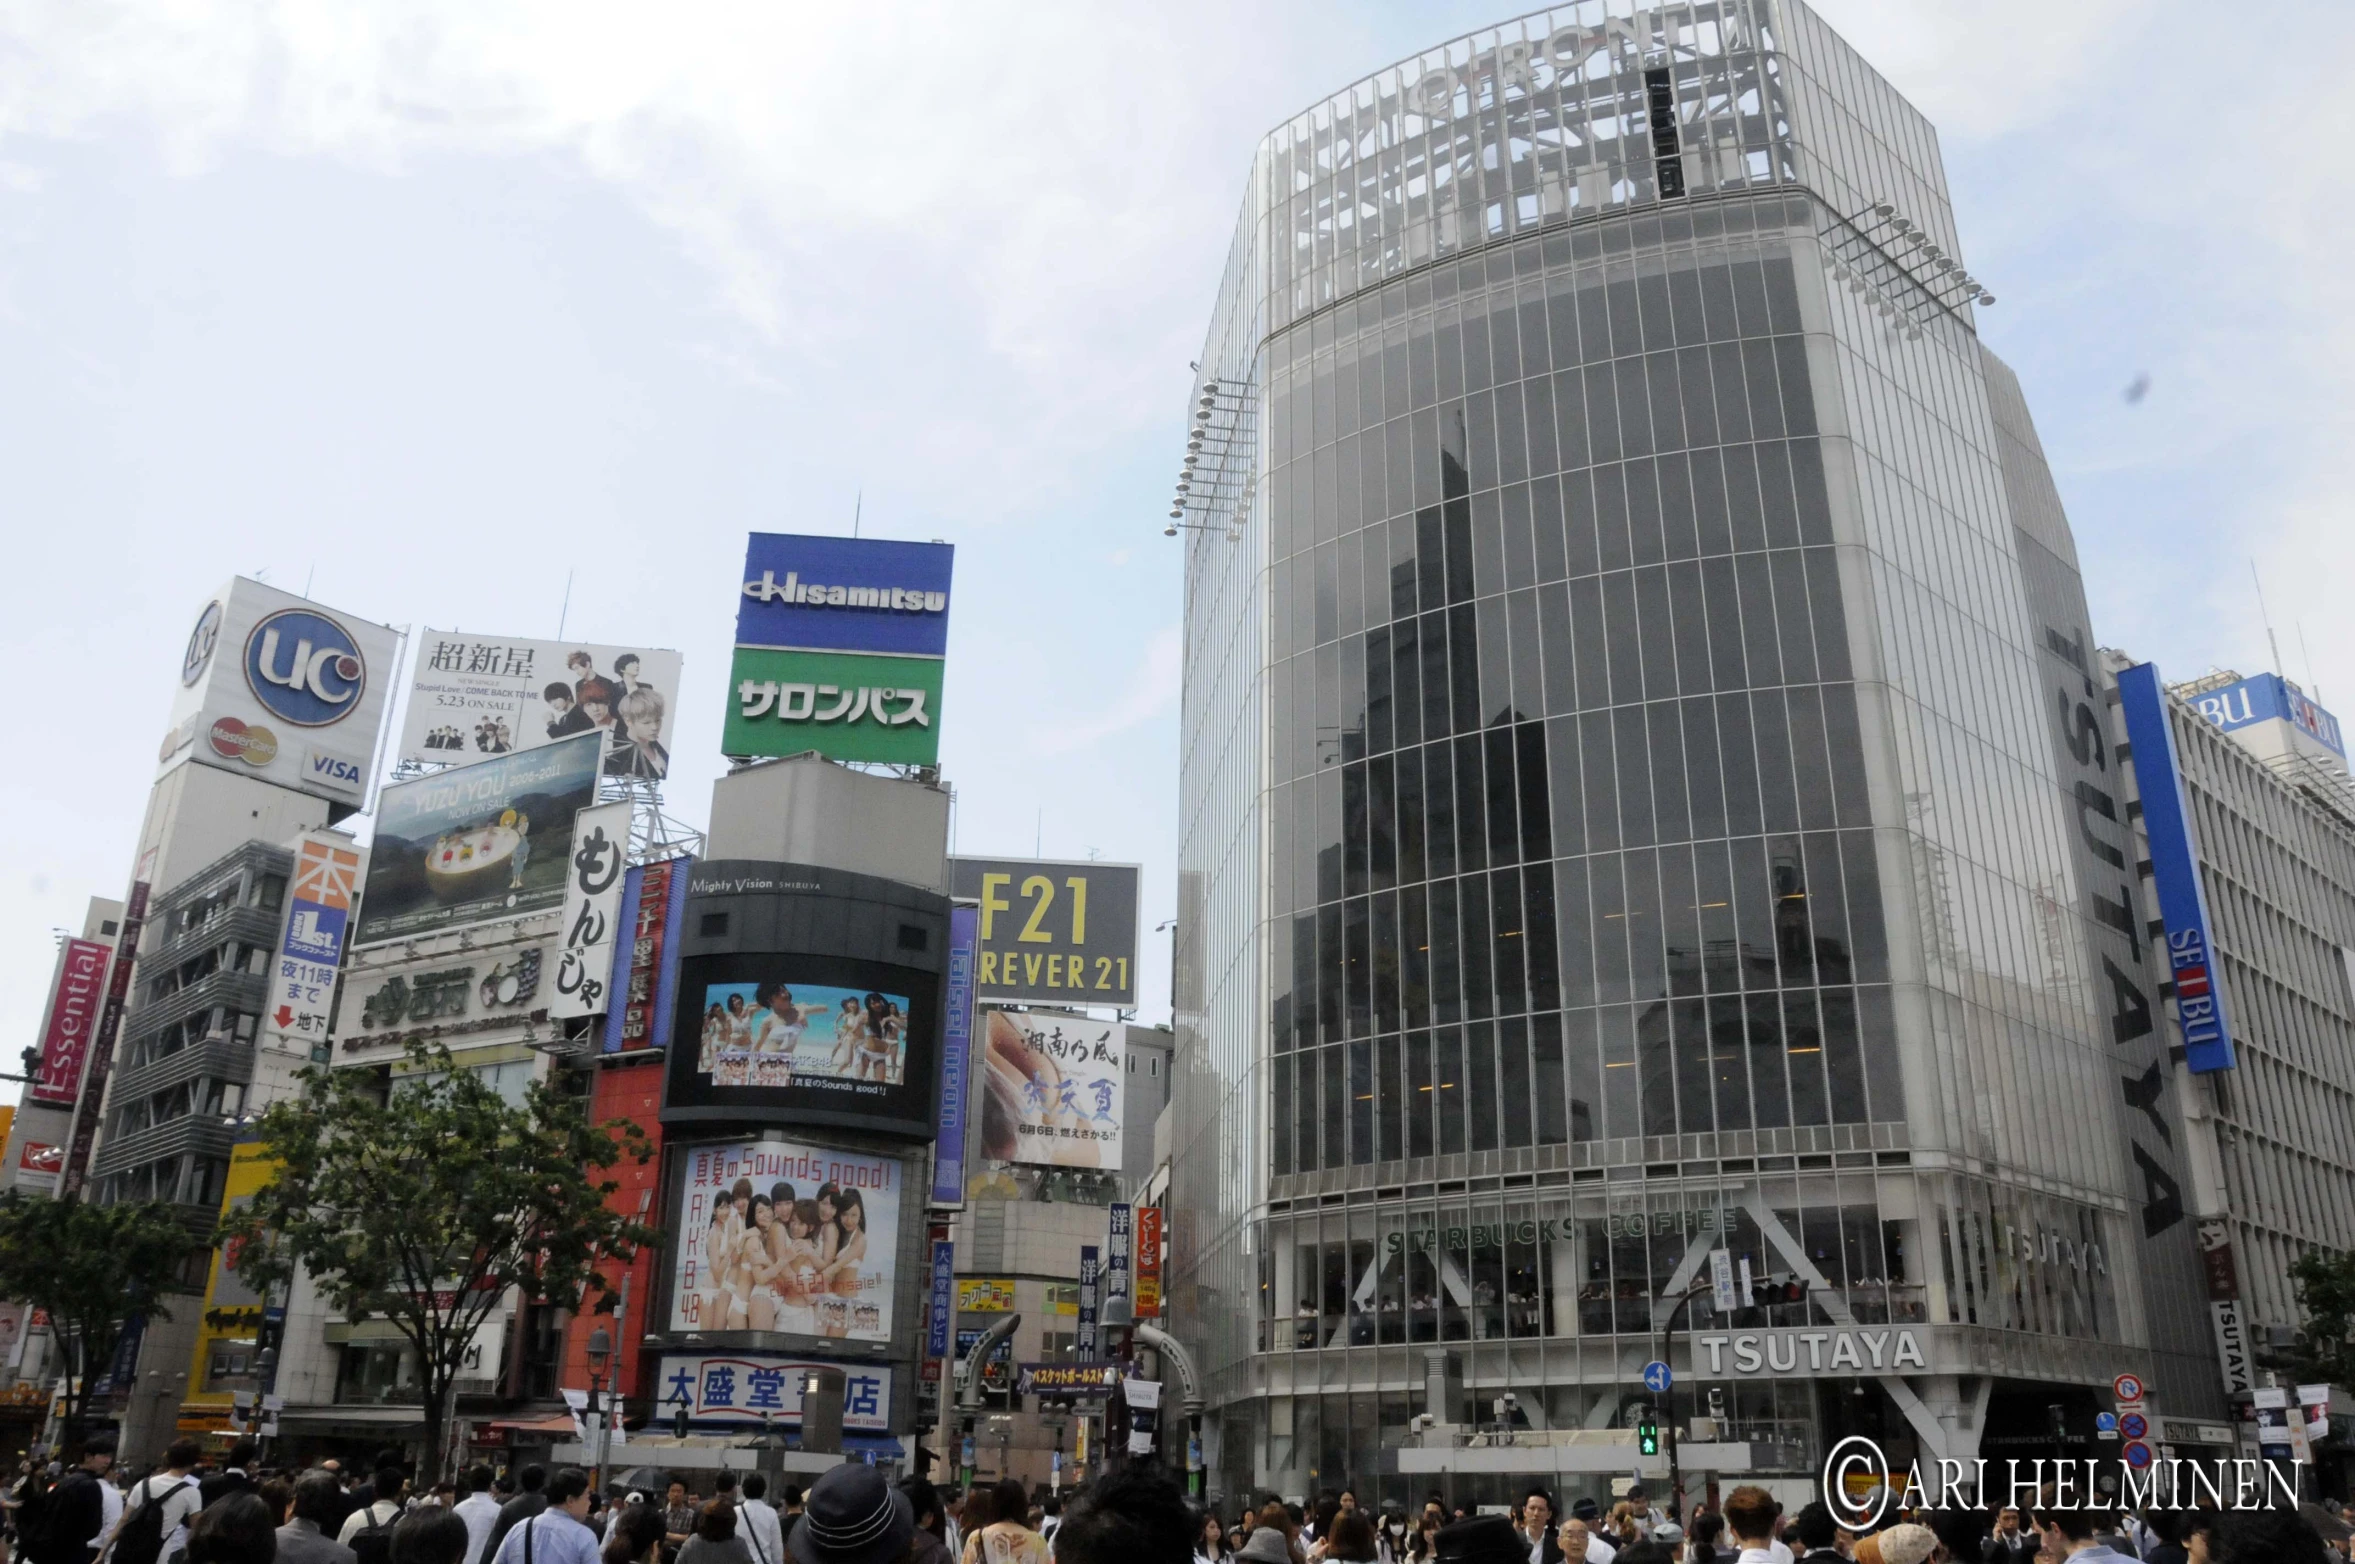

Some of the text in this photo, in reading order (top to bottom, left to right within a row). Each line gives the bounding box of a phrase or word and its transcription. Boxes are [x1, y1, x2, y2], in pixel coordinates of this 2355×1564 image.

[742, 570, 945, 612] Hisamitsu
[428, 641, 535, 679] 超新星
[415, 683, 438, 693] Stupid
[439, 685, 461, 694] Love
[466, 687, 490, 697] COME
[491, 689, 513, 698] BACK
[514, 691, 525, 699] TO
[527, 691, 539, 700] ME
[436, 694, 514, 712] 5.23 ON SALE
[737, 679, 930, 727] サロンパス
[211, 727, 277, 757] MasterCard
[313, 756, 360, 784] VISA
[414, 781, 460, 815] YUZU
[467, 773, 507, 801] YOU
[448, 796, 511, 820] NOW ON SALE
[296, 847, 359, 907] 本
[691, 878, 821, 894] Mighty Vision SHIBUYA
[291, 912, 305, 941] BOOK
[557, 826, 620, 1010] もんじゃ
[982, 873, 1087, 945] F21
[288, 939, 337, 958] ブックファースト
[2045, 624, 2184, 1240] TSUTAYA
[280, 959, 335, 987] 夜11時
[622, 867, 664, 1039] 三千里薬品
[287, 983, 321, 1005] まで
[1095, 957, 1127, 991] 21
[2168, 927, 2219, 1047] SEIBU
[36, 944, 99, 1095] Essential
[297, 1011, 327, 1033] 地下
[1021, 1026, 1118, 1067] 湘南乃風
[941, 1046, 961, 1128] neon
[829, 1160, 891, 1192] good!
[1387, 1208, 1738, 1255] STARBUCKS COFFEE
[1109, 1208, 1129, 1298] 洋服の青
[934, 1248, 951, 1349] 大盛堂商事ビル
[1701, 1331, 1926, 1374] TSUTAYA
[2219, 1301, 2248, 1394] TSUTAYA
[2163, 1422, 2200, 1441] TSUTAYA
